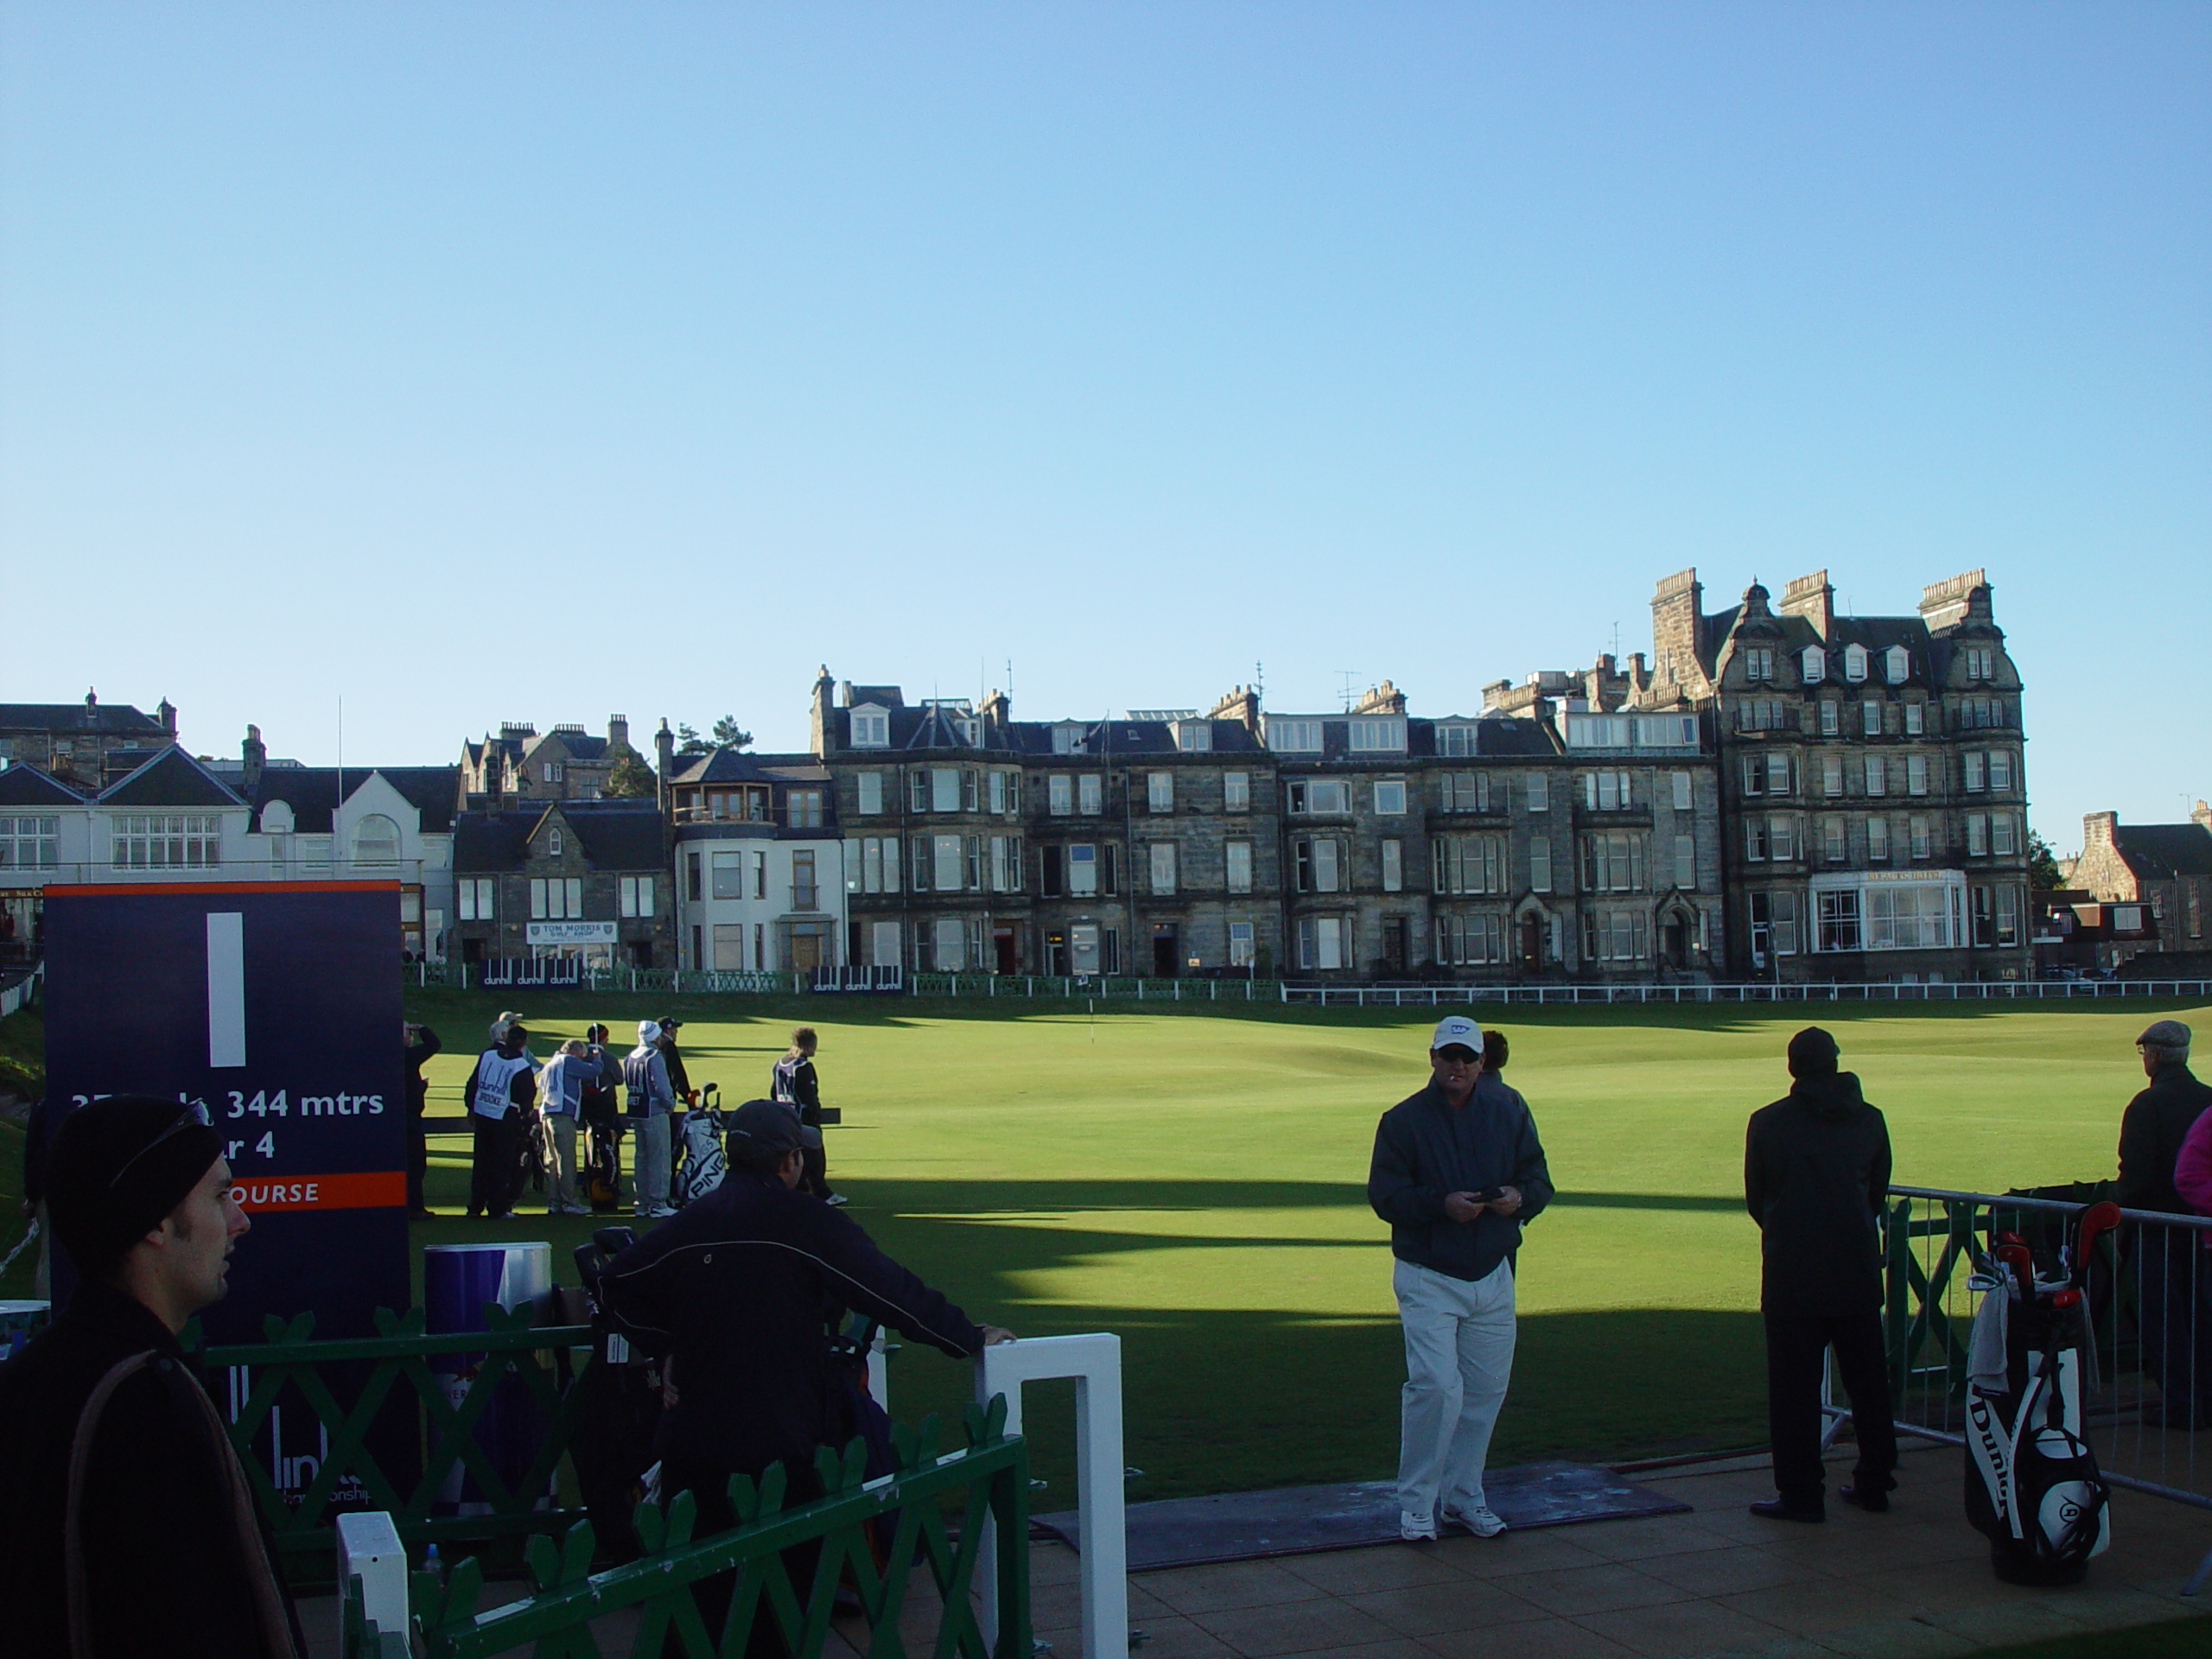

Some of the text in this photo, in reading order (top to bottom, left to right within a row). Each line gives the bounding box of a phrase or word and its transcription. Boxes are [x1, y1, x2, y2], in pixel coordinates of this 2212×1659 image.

[1912, 871, 1942, 880] HOTEL
[484, 958, 578, 985] dunhill dunhill dunhill
[814, 965, 902, 991] dunhill dunhill dunhill
[226, 1090, 385, 1118] 344 mtrs
[255, 1130, 276, 1159] 4
[690, 1154, 724, 1198] PING
[231, 1183, 320, 1205] OURSE
